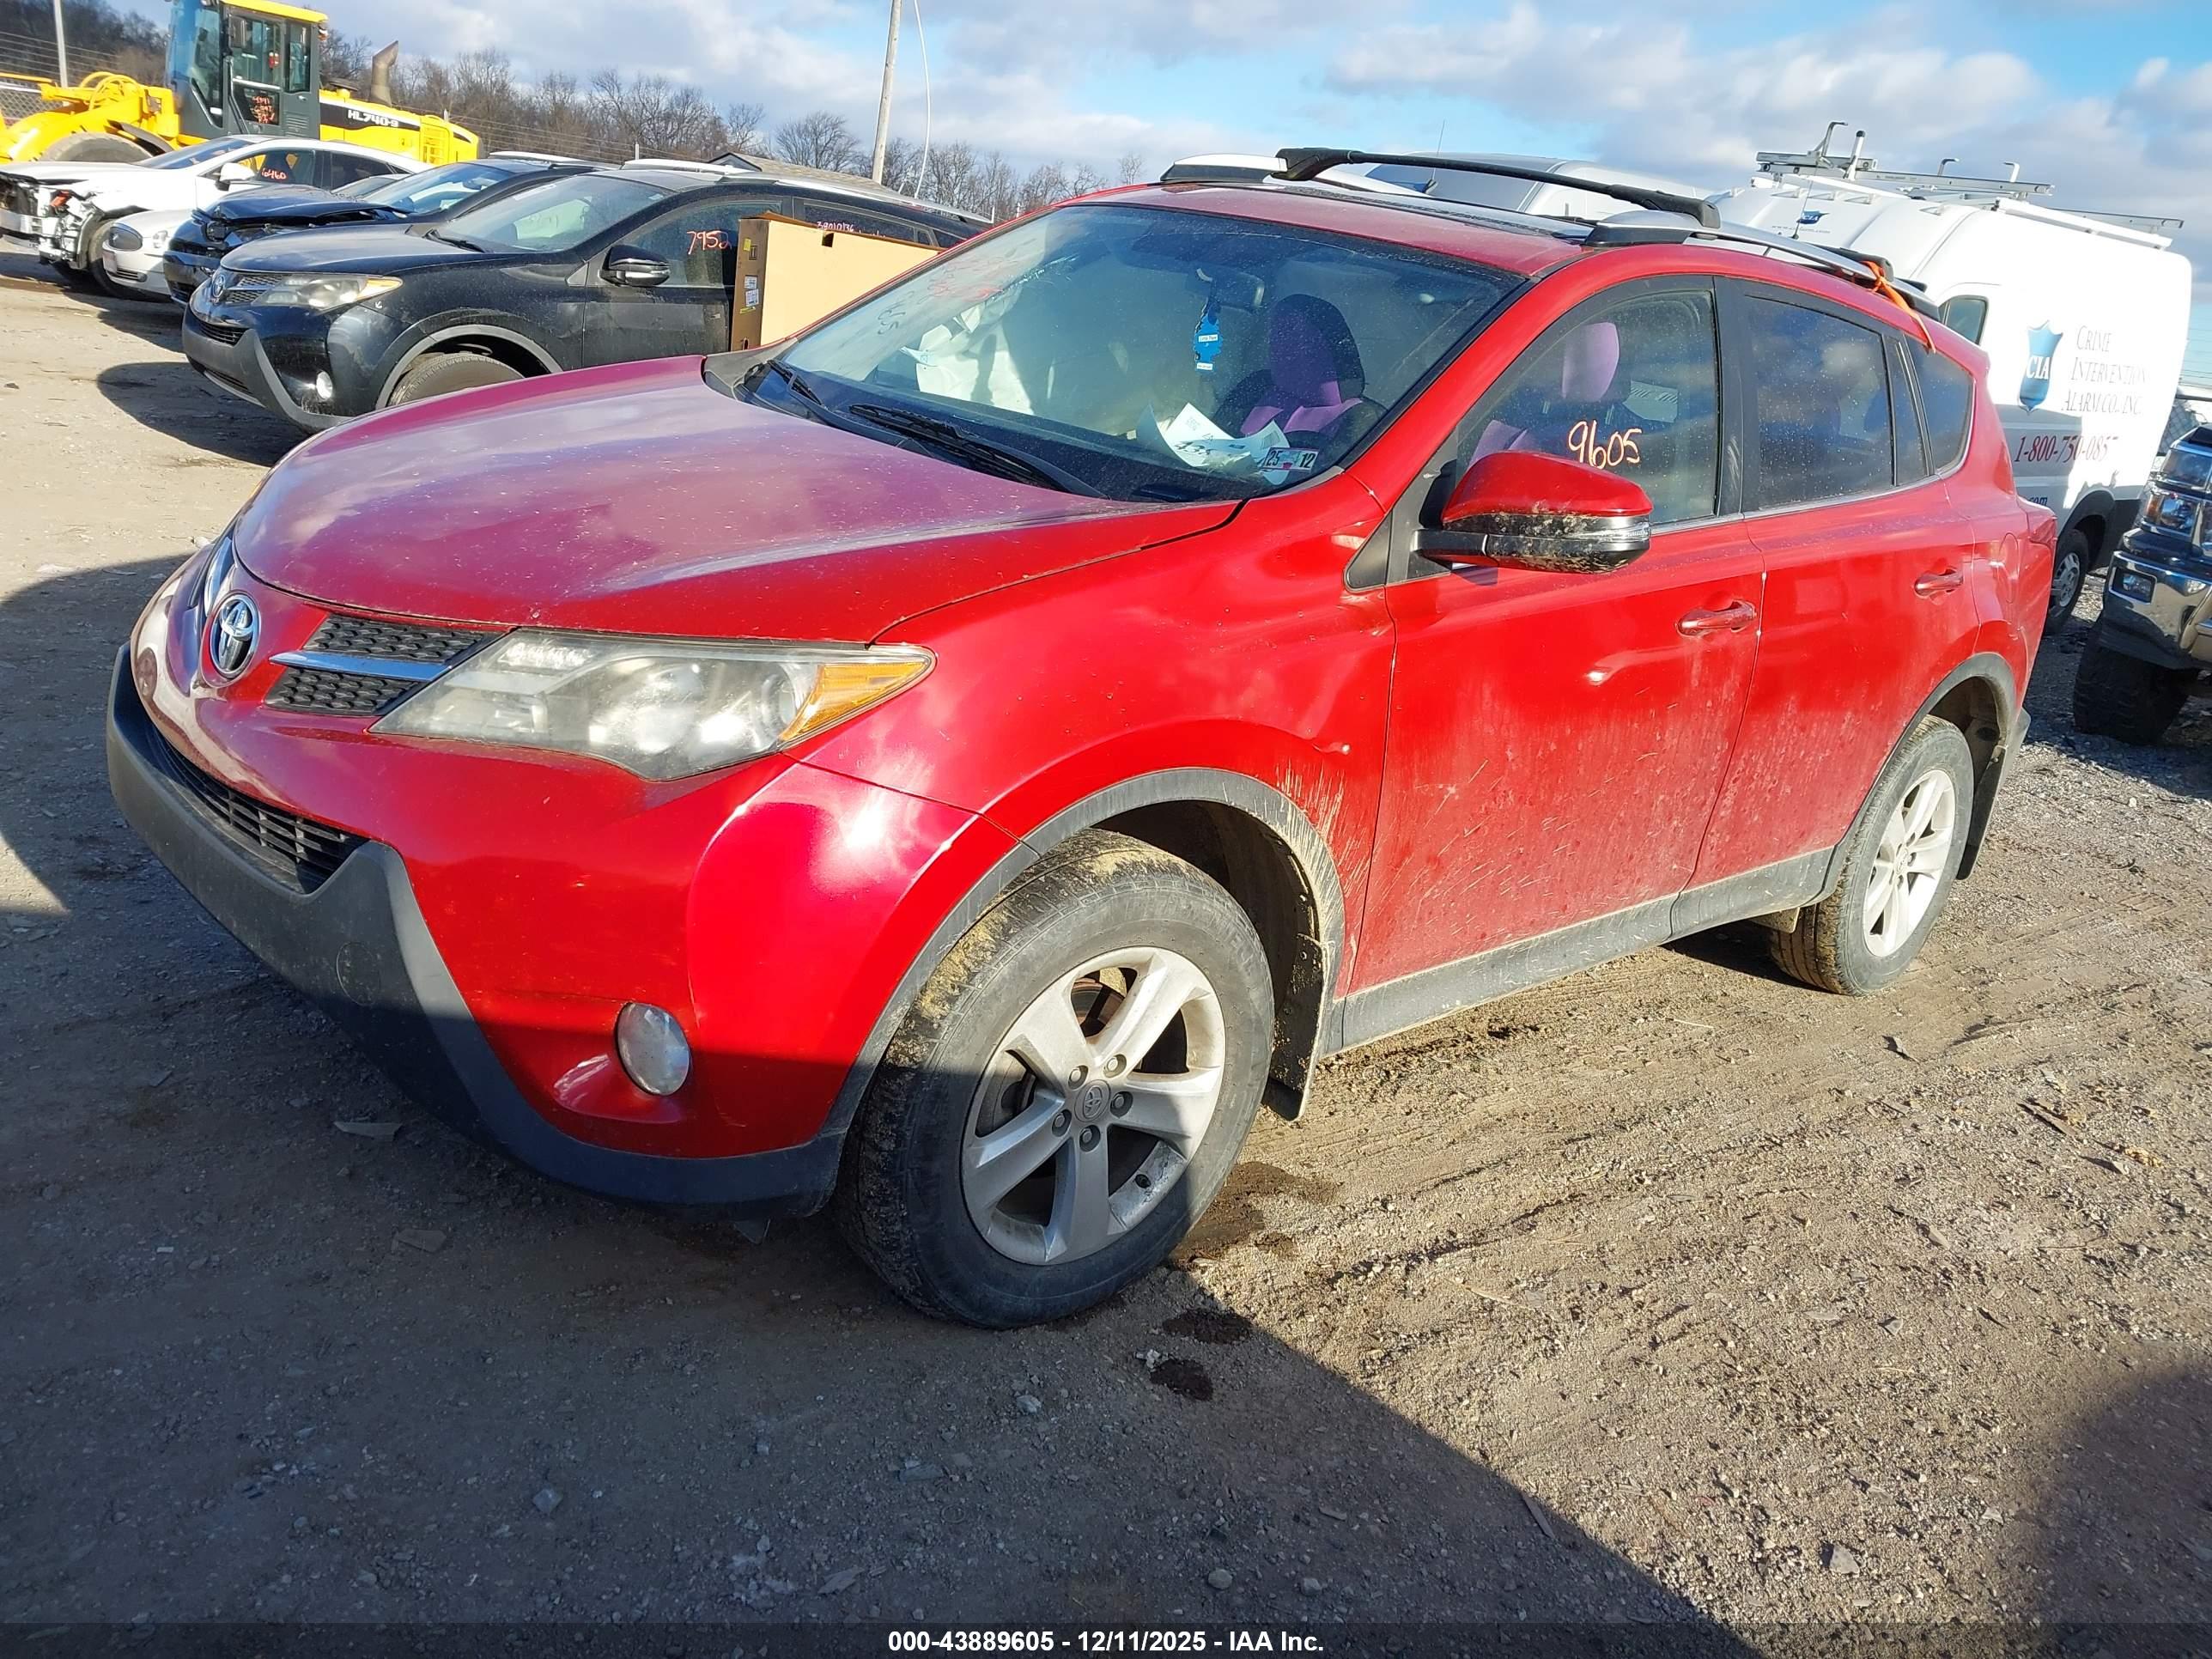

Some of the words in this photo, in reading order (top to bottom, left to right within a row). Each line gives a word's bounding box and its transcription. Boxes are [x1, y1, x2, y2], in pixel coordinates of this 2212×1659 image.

[348, 109, 399, 128] HL740-9
[686, 230, 732, 255] 7952
[2027, 356, 2051, 379] CIA
[1568, 419, 1643, 470] 9605
[1267, 450, 1283, 466] 25
[1299, 453, 1316, 469] 12
